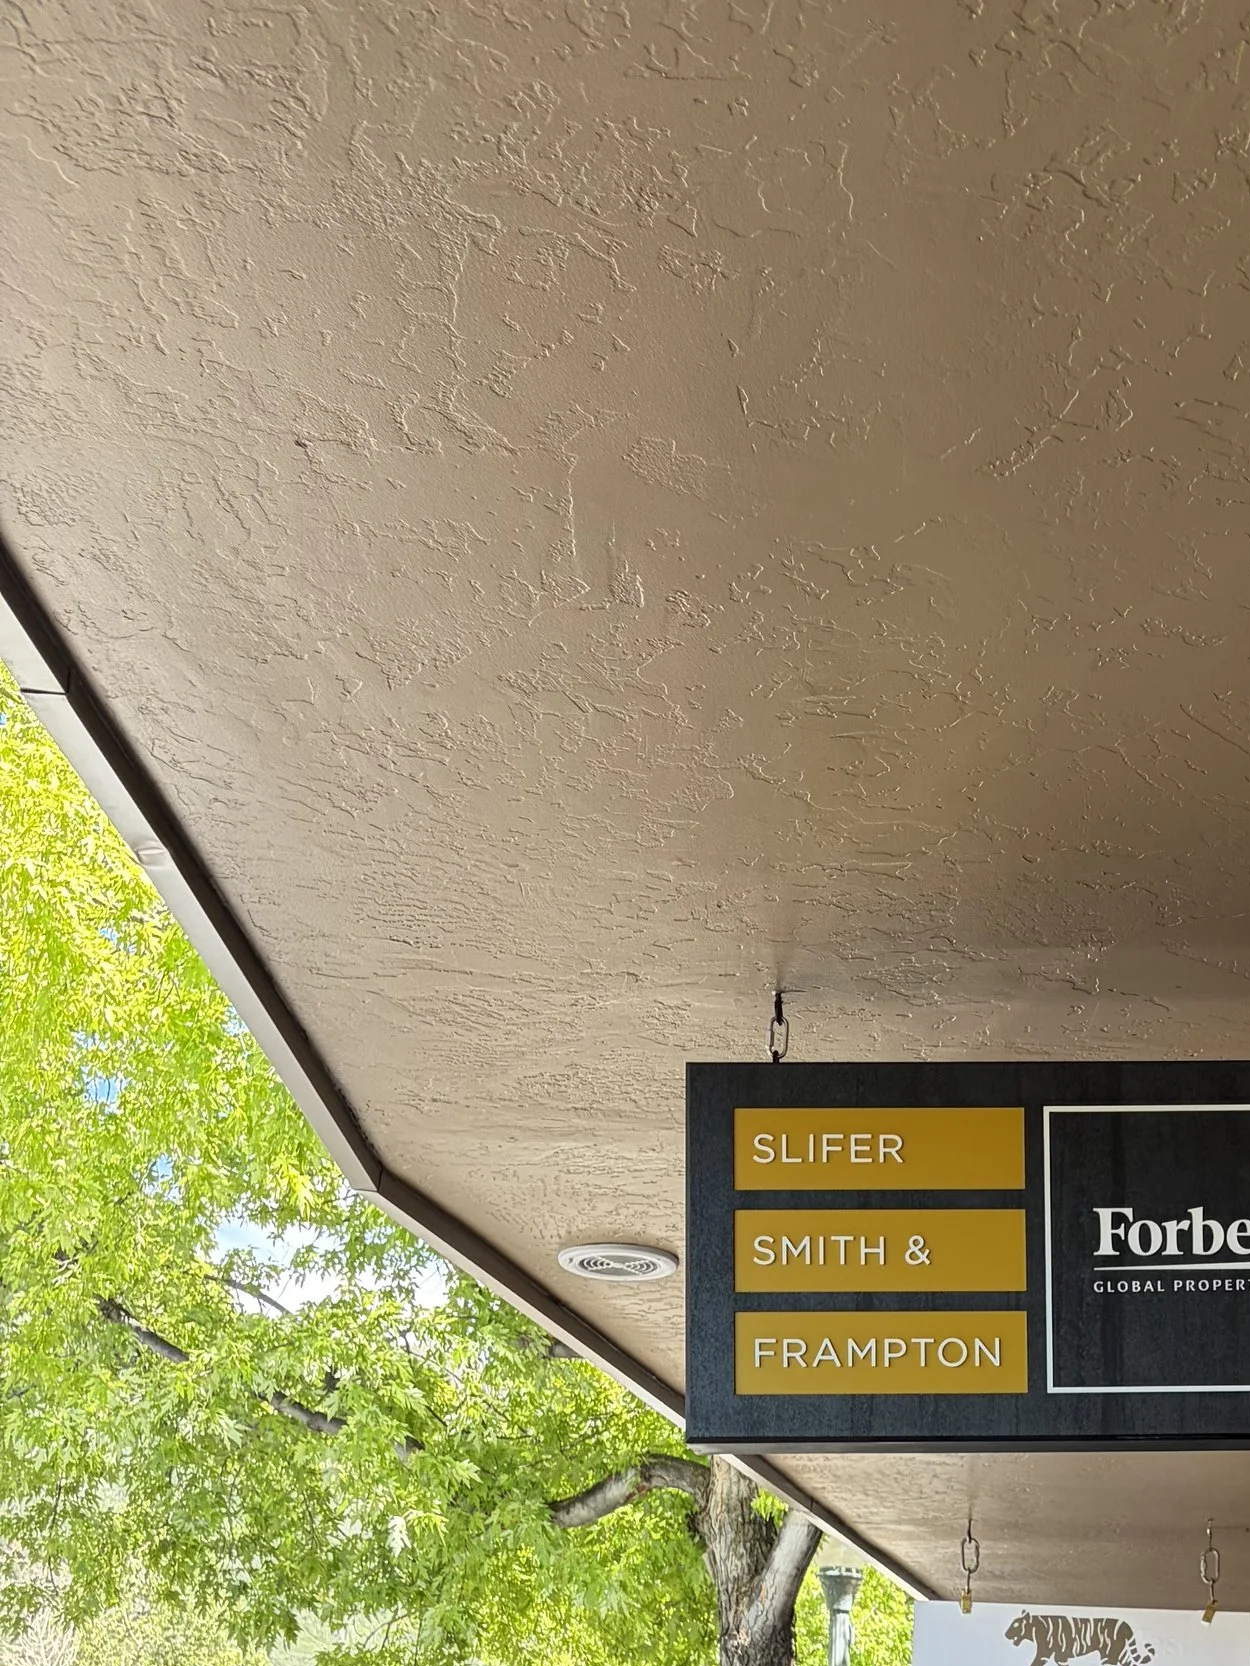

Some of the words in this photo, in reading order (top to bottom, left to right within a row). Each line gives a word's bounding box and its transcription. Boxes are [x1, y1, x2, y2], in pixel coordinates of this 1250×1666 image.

[752, 1133, 905, 1165] SLIFER
[752, 1236, 885, 1266] SMITH
[904, 1236, 931, 1266] &
[1093, 1279, 1165, 1293] GLOBAL
[752, 1336, 1002, 1368] FRAMPTON
